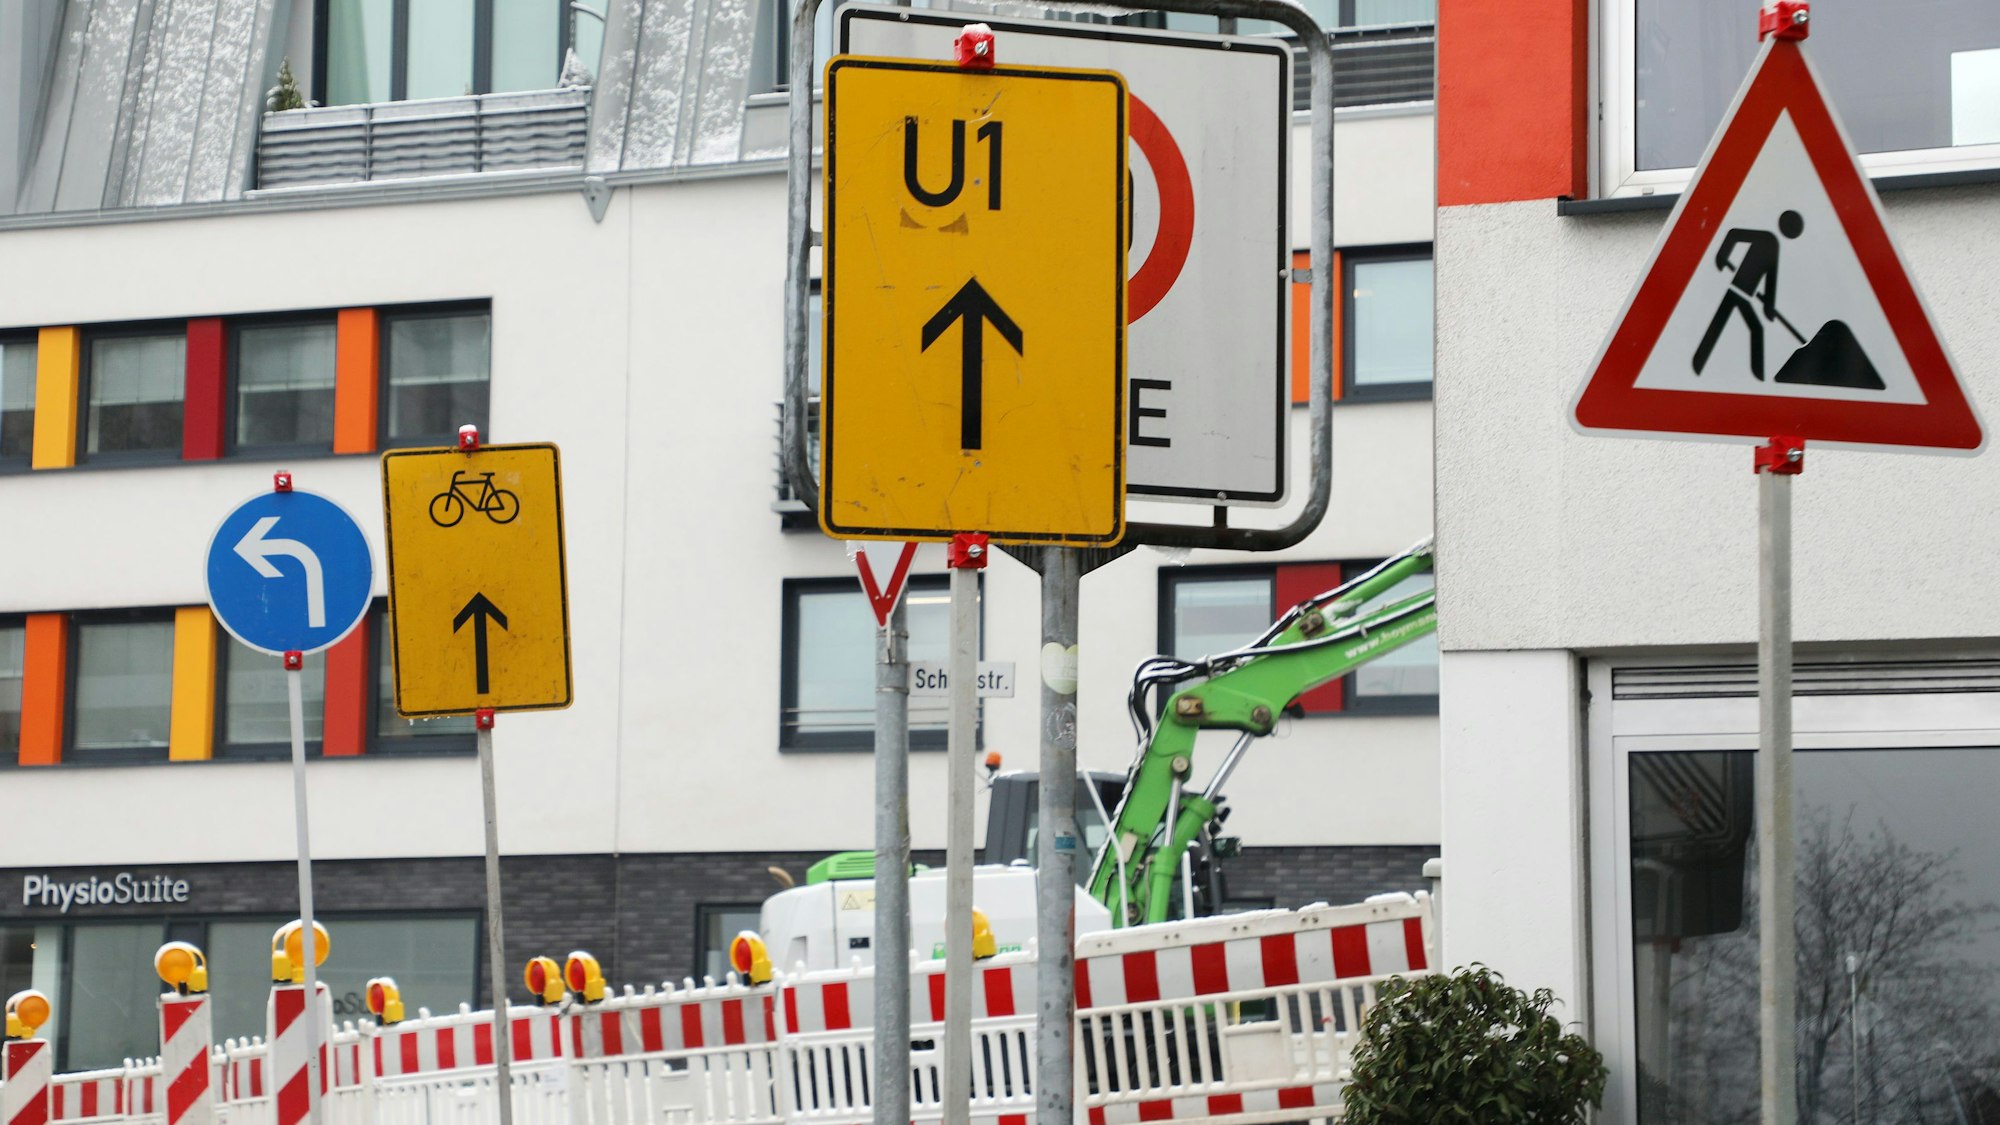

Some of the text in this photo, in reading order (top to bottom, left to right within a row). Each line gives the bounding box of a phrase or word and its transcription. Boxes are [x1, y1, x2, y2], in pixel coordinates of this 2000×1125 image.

[904, 116, 1003, 211] U1
[915, 668, 1009, 690] Schstr.
[22, 872, 190, 914] PhysioSuite
